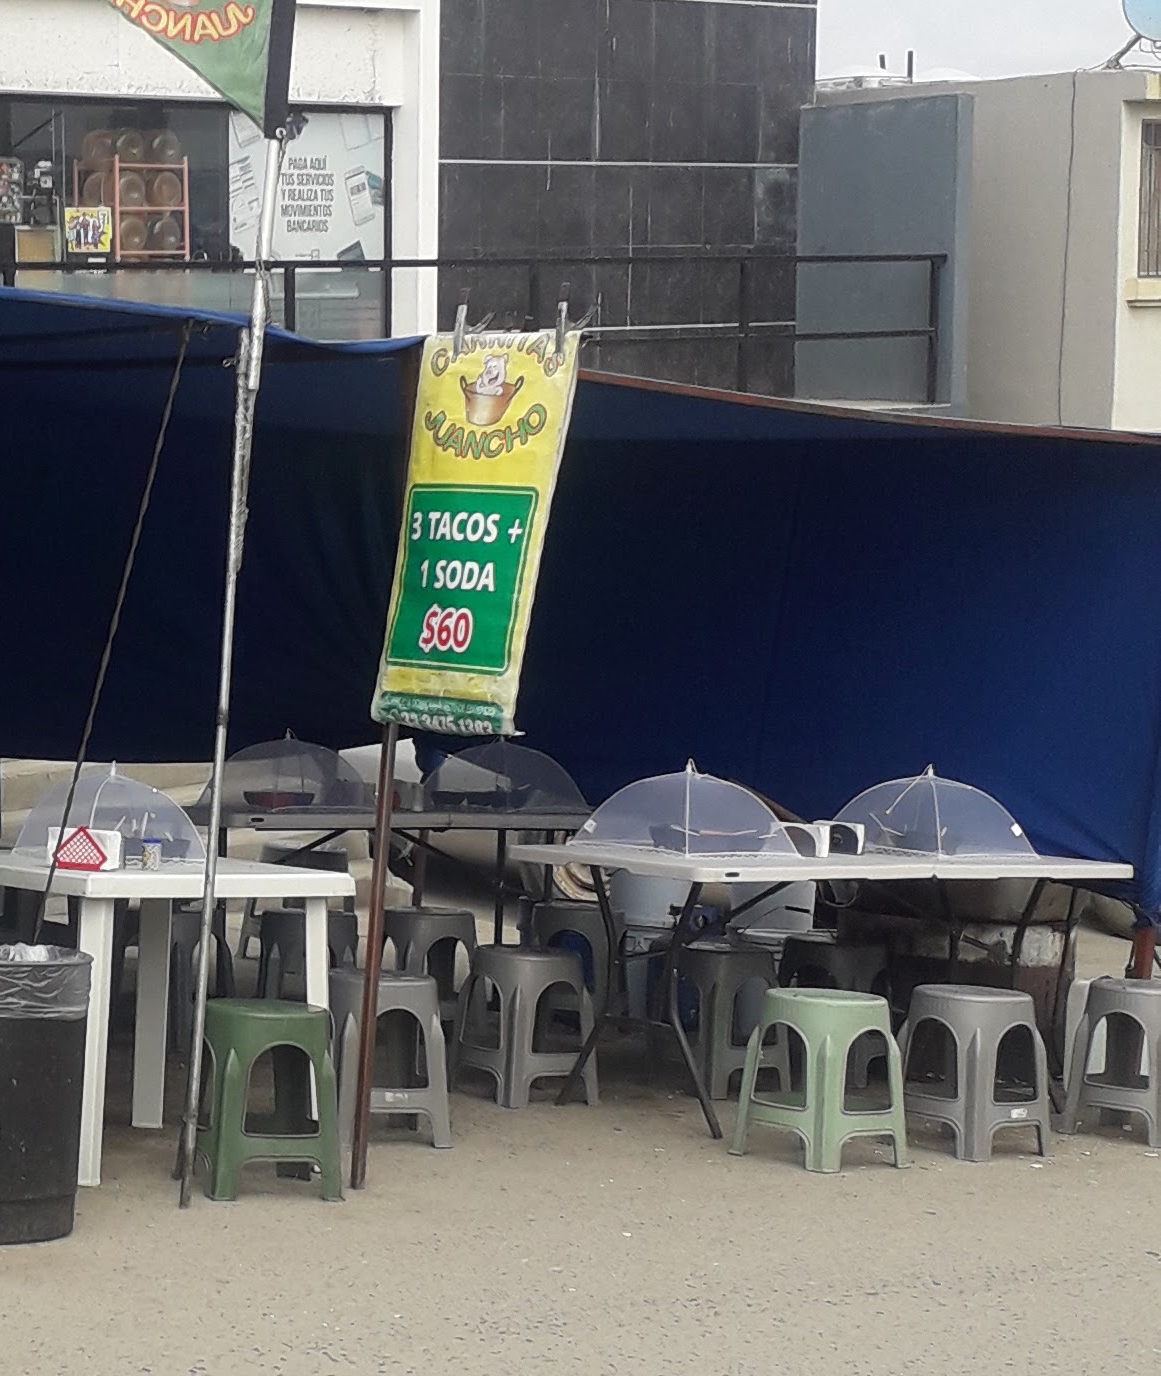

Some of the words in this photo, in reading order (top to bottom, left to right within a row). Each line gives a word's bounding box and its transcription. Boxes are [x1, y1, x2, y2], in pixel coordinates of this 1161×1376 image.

[289, 157, 308, 171] PAGA
[281, 173, 296, 187] TUS
[296, 173, 335, 187] SERVICIOS
[281, 188, 287, 202] Y
[288, 188, 318, 202] REALIZA
[320, 188, 335, 202] TUS
[280, 204, 333, 218] MOVIMIENTOS
[286, 219, 329, 233] BANCARIOS
[424, 402, 548, 460] JUANCHO
[410, 511, 423, 541] 3
[427, 510, 502, 543] TACOS
[420, 559, 429, 589] 1
[433, 559, 496, 593] SODA
[420, 604, 474, 656] $60
